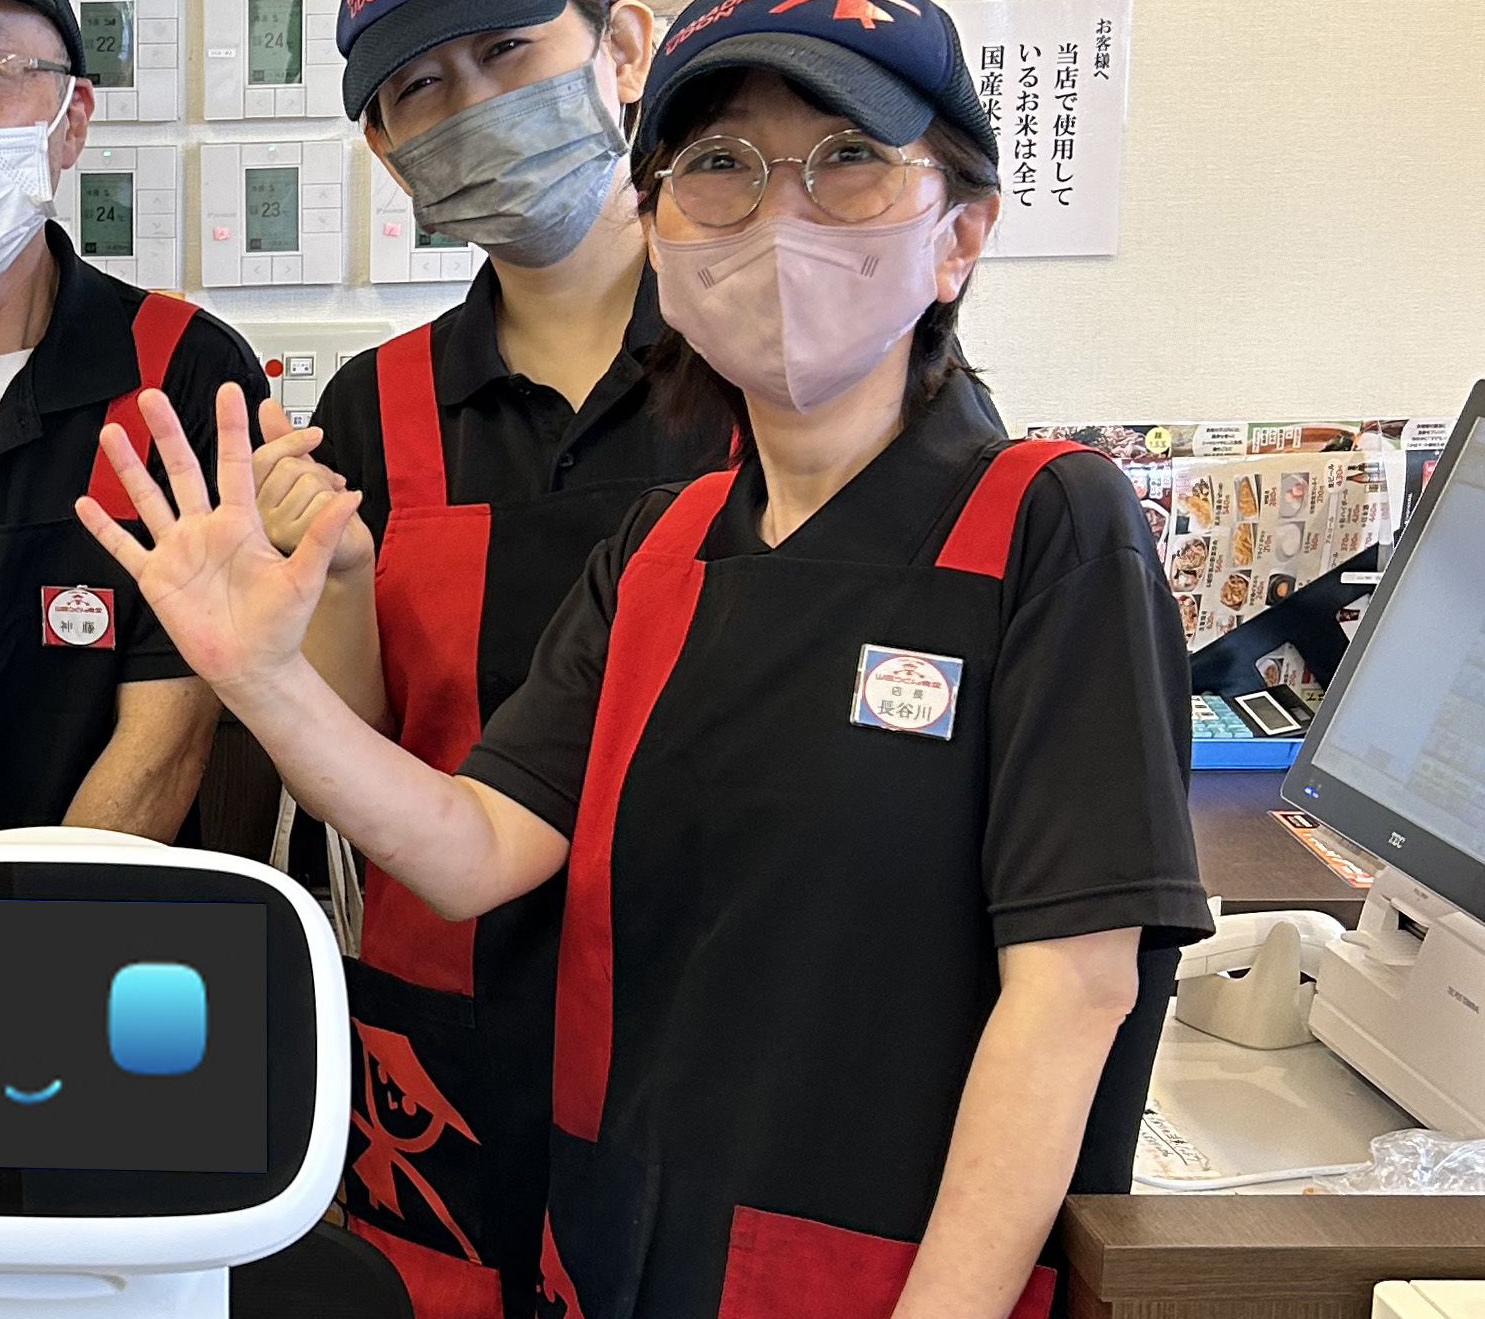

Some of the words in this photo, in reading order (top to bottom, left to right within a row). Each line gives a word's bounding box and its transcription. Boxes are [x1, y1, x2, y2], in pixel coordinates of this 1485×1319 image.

[96, 36, 116, 53] 22
[1092, 18, 1112, 81] お客様へ
[1012, 43, 1042, 208] いるお米は全て
[1050, 42, 1079, 207] 当店で使用して
[96, 206, 115, 222] 24
[261, 201, 281, 218] 23
[878, 699, 933, 722] 長谷川
